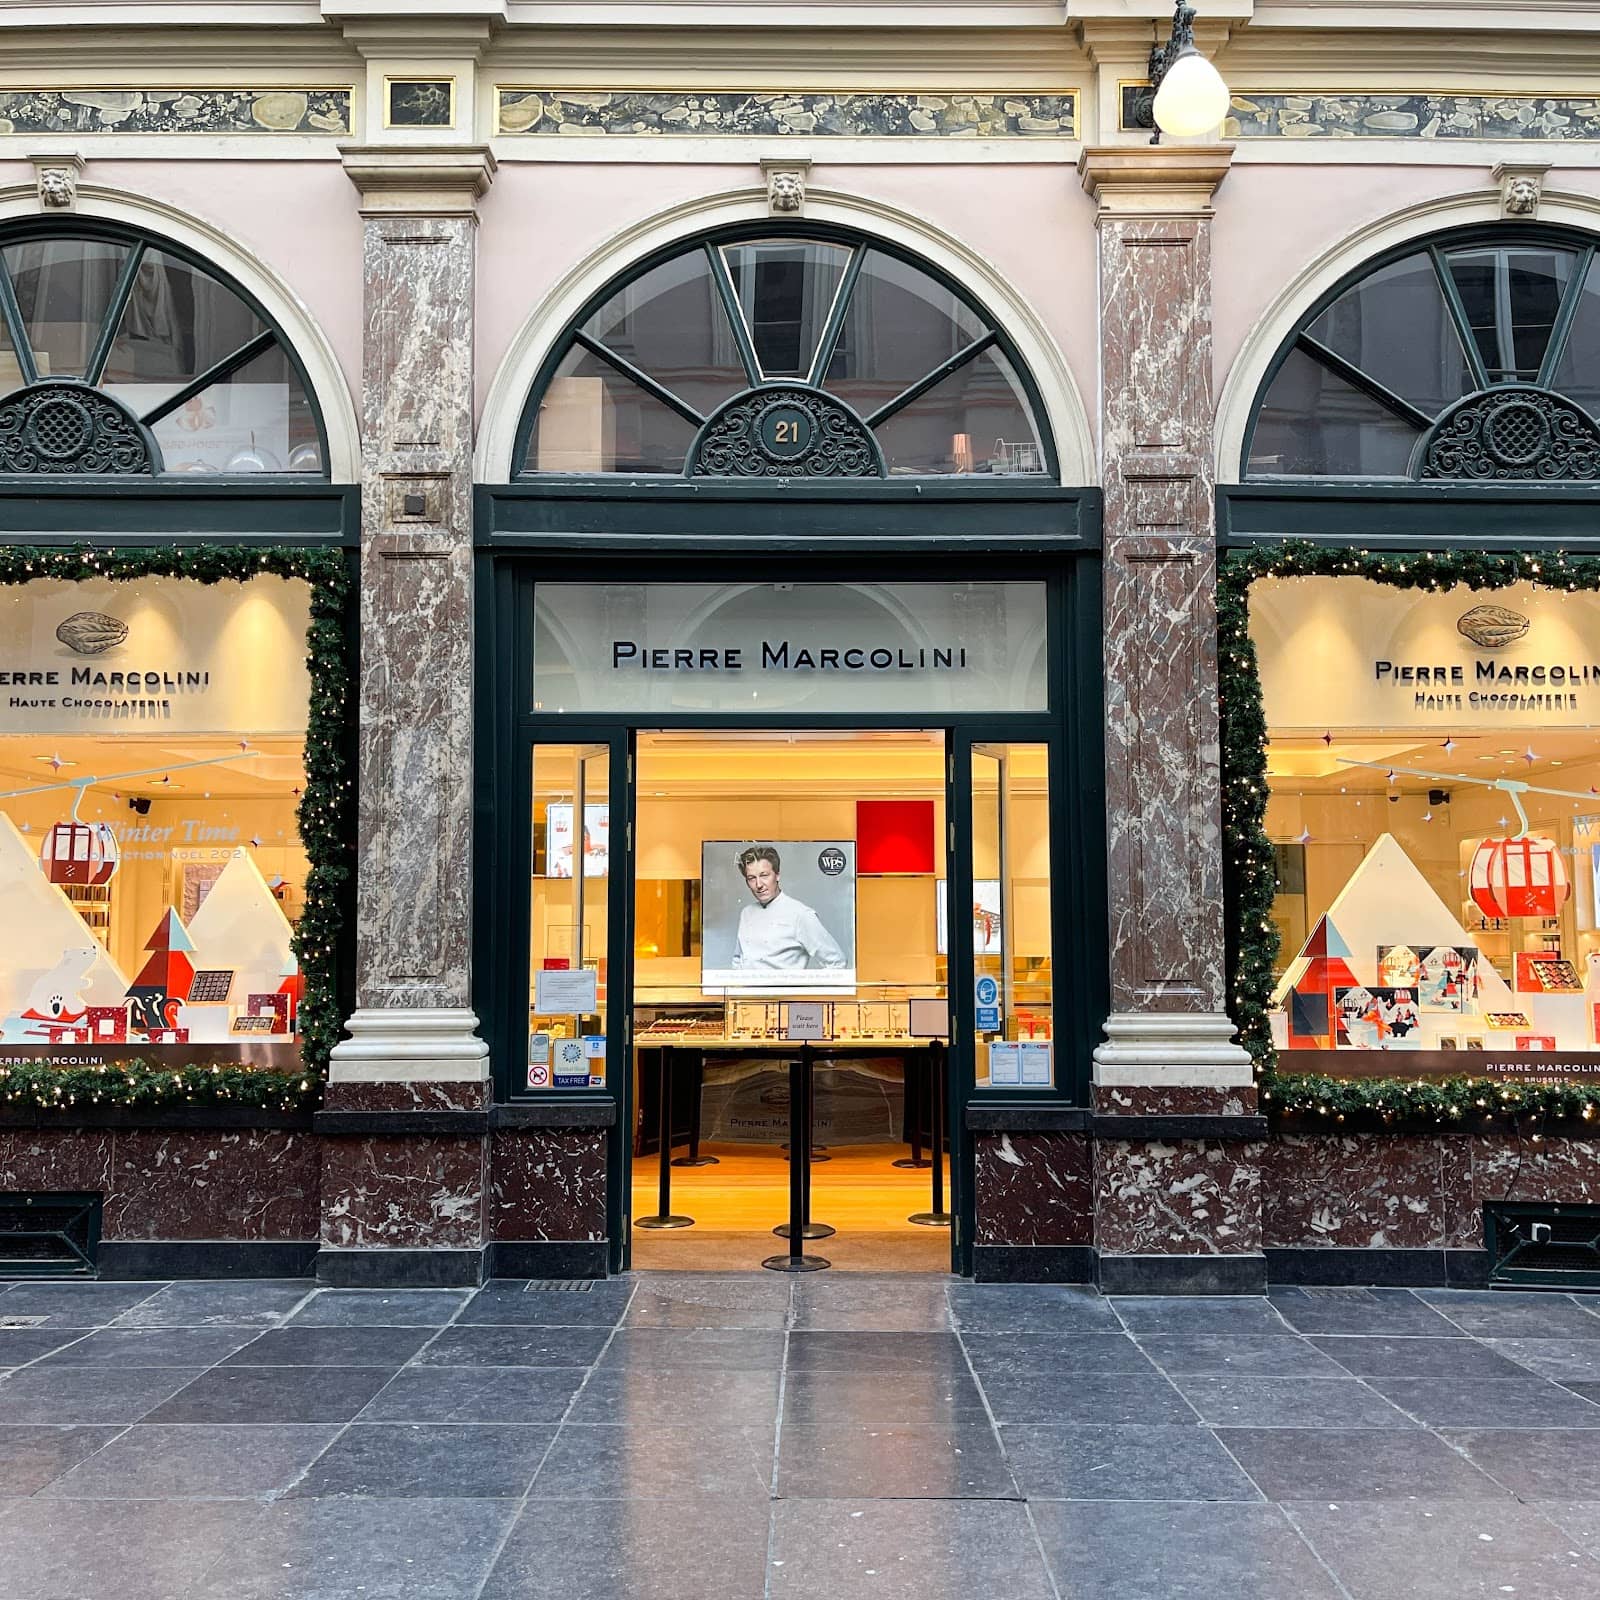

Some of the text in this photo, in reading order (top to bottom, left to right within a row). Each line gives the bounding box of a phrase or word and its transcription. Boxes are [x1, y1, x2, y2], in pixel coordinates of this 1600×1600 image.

[775, 420, 798, 443] 21
[613, 641, 966, 669] PIERRE MARCOLINI
[71, 667, 209, 685] MARCOLINI
[1375, 660, 1463, 680] PIERRE
[9, 697, 170, 708] HAUTE CHOCOLATERIE
[1415, 691, 1577, 702] HAUTE CHOCOLATERIE
[182, 819, 240, 843] Time
[1486, 1063, 1531, 1072] PIERRE
[558, 1077, 585, 1085] TAX FREE
